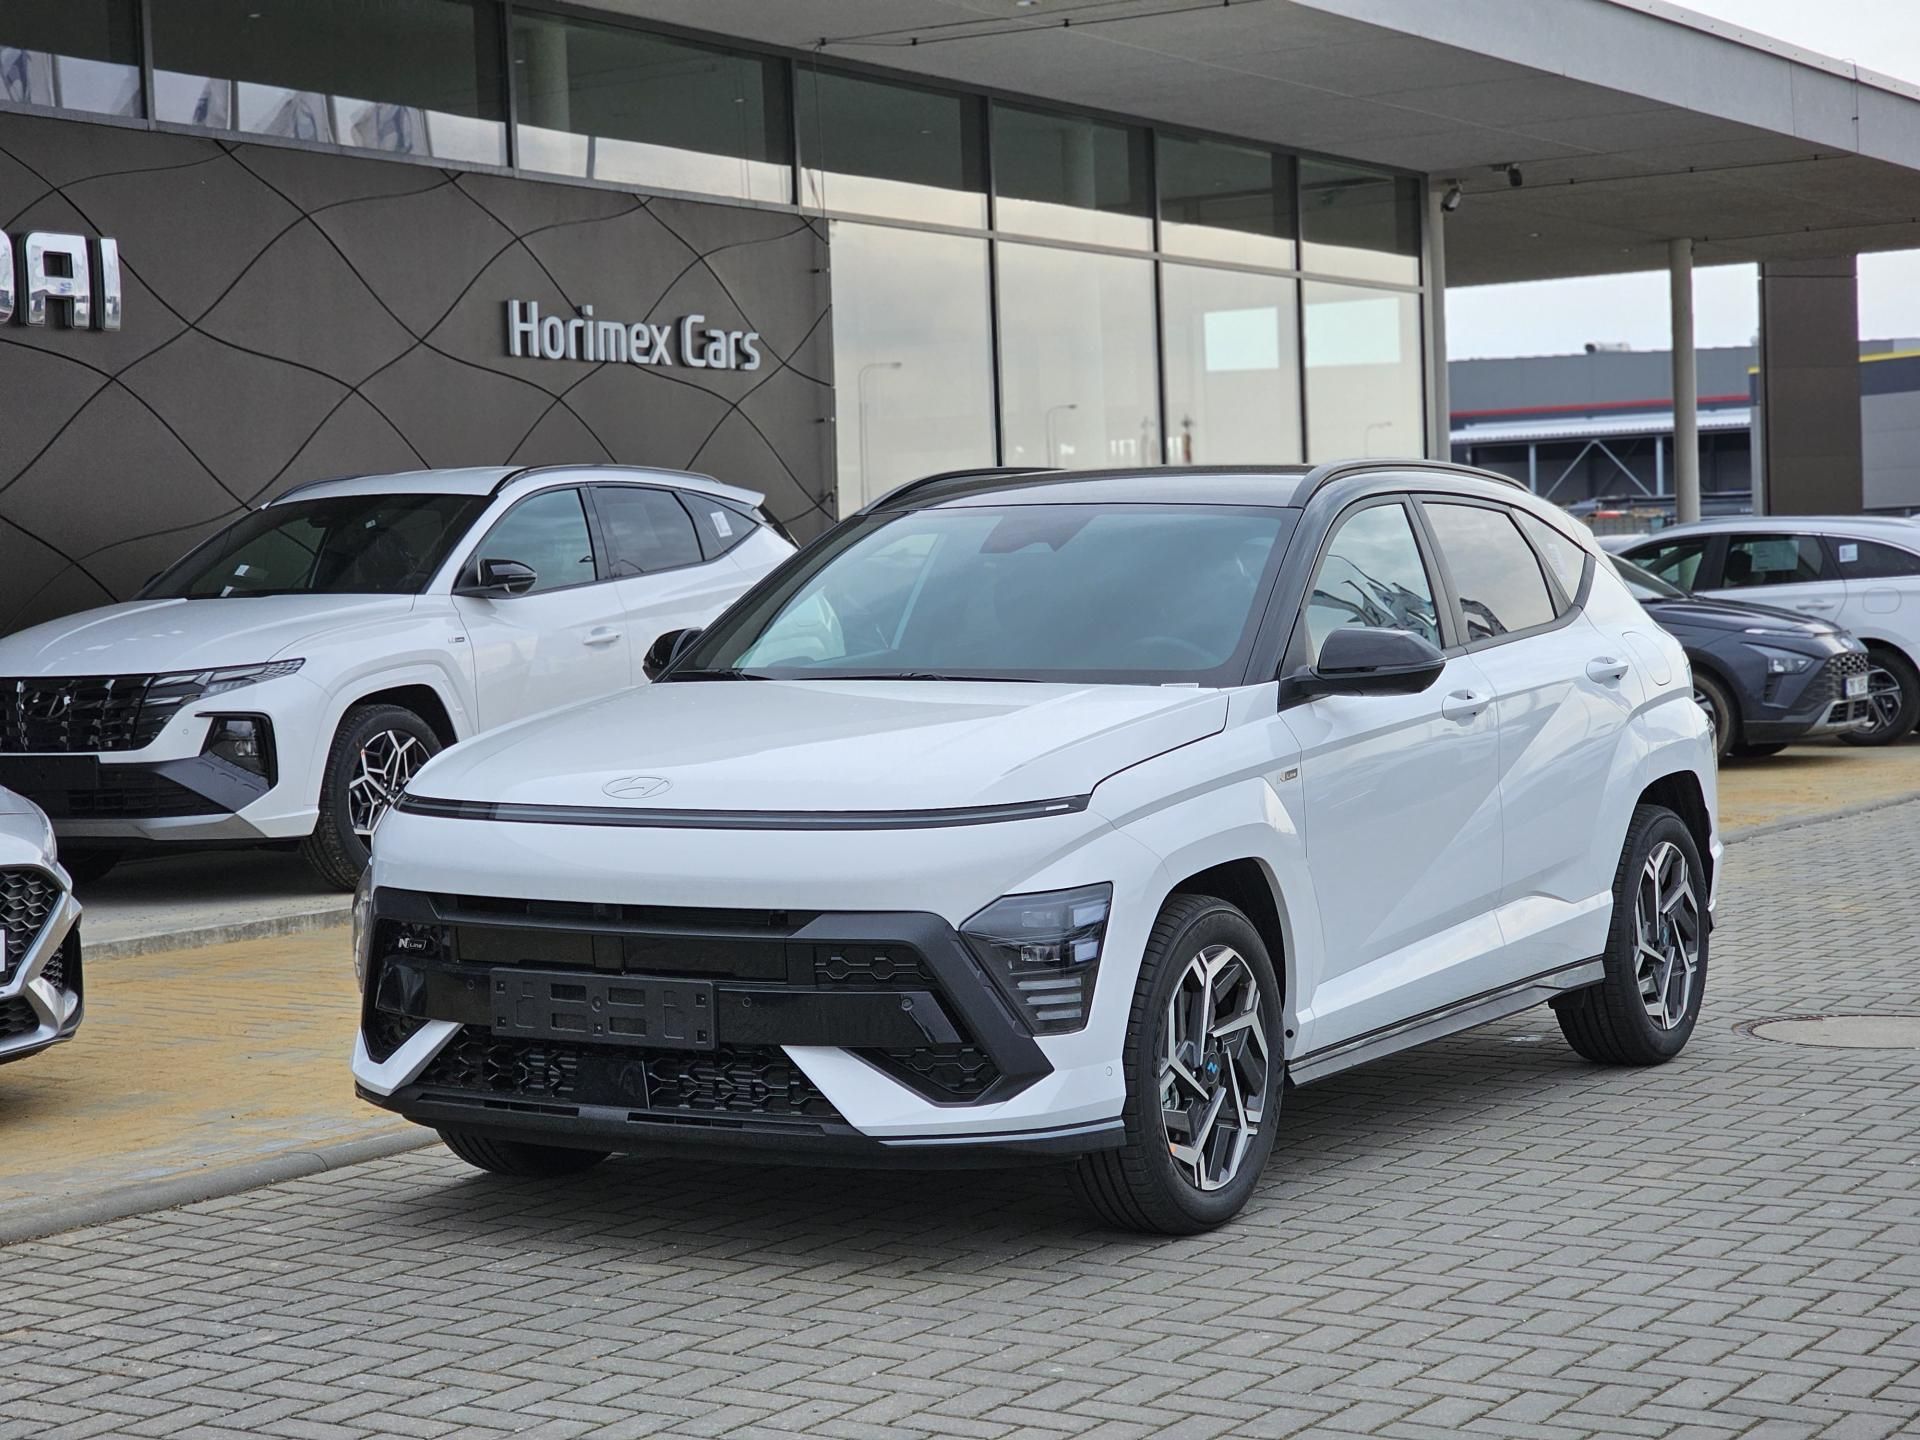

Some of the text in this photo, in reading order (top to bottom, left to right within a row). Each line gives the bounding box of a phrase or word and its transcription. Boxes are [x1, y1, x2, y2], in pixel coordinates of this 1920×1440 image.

[0, 228, 121, 331] AI
[508, 299, 761, 370] Horimex Cars
[398, 937, 410, 949] N
